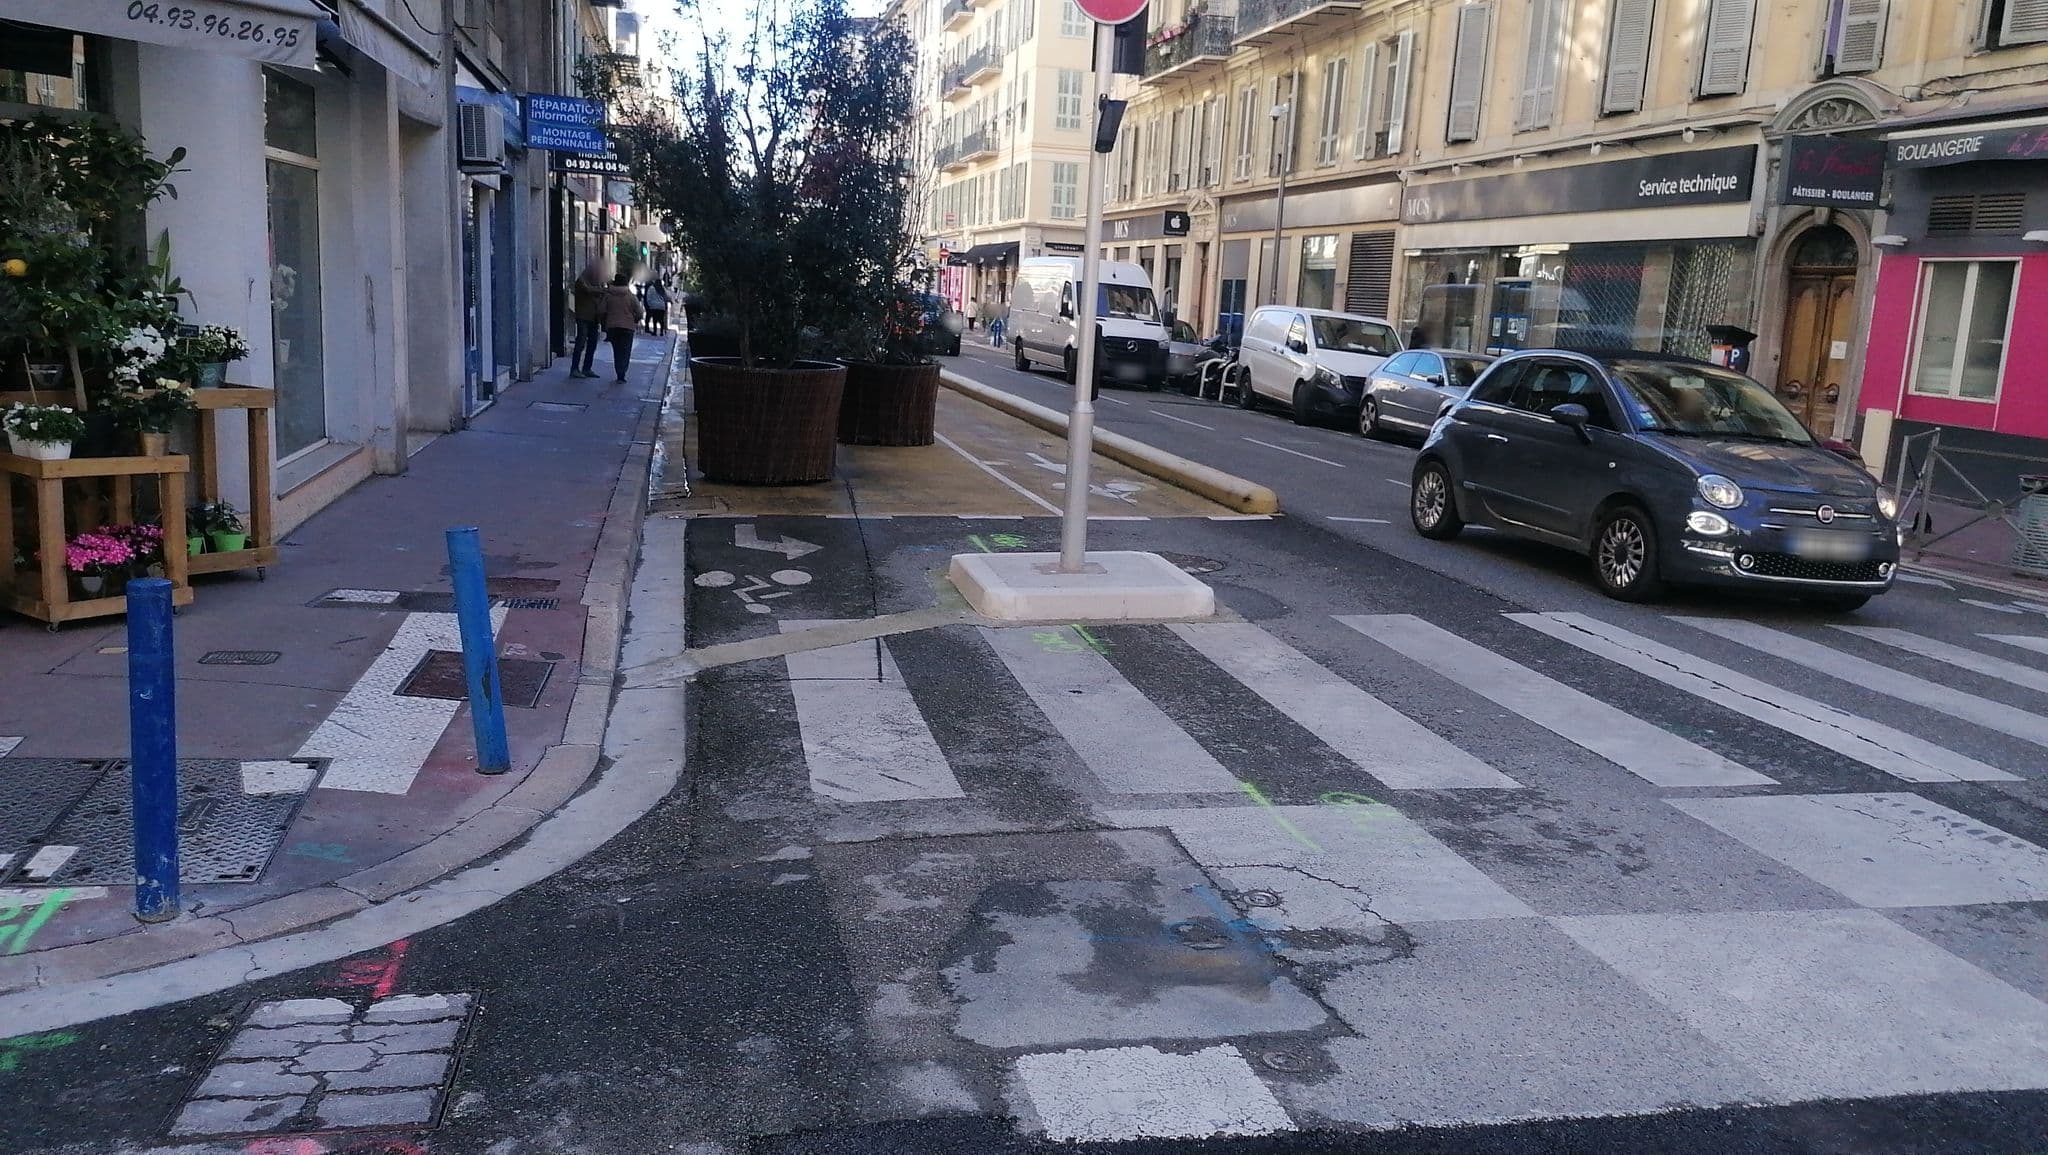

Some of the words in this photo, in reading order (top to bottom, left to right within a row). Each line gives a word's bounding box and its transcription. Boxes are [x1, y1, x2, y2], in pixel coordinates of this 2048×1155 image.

[127, 1, 299, 47] 04.93.96.26.95
[531, 134, 603, 151] PERSONNALISÉ
[542, 127, 592, 141] MONTAGE
[1897, 136, 1984, 161] BOULANGERIE
[566, 159, 577, 168] 04
[579, 160, 591, 170] 93
[592, 161, 604, 171] 44
[605, 162, 617, 172] 04
[1639, 178, 1677, 197] Service
[1679, 174, 1737, 194] technique
[1792, 185, 1825, 198] PÂTISSIER
[1832, 189, 1874, 201] BOULANGER
[1406, 197, 1431, 217] MCS
[1114, 221, 1129, 238] MCS
[1731, 348, 1740, 363] P
